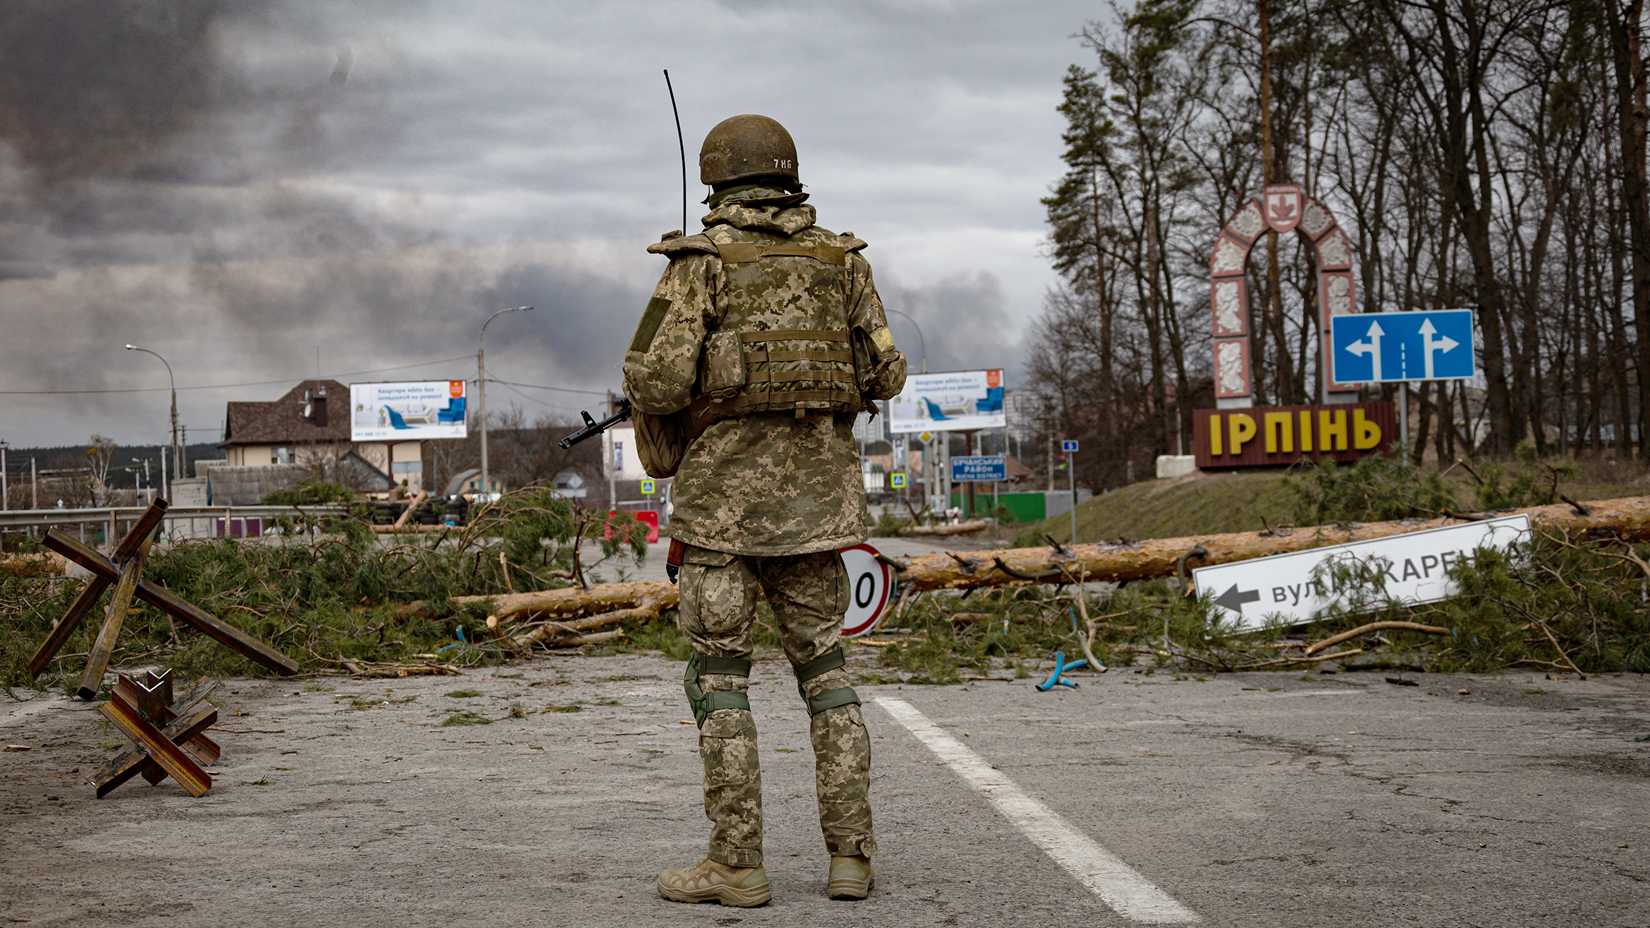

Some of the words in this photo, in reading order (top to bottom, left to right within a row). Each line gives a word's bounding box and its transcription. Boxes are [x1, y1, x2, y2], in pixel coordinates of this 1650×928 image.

[1210, 409, 1382, 455] ІРПІНЬ
[953, 458, 1004, 467] БУЧАНСЬКИЙ
[964, 465, 993, 473] РАЙОН
